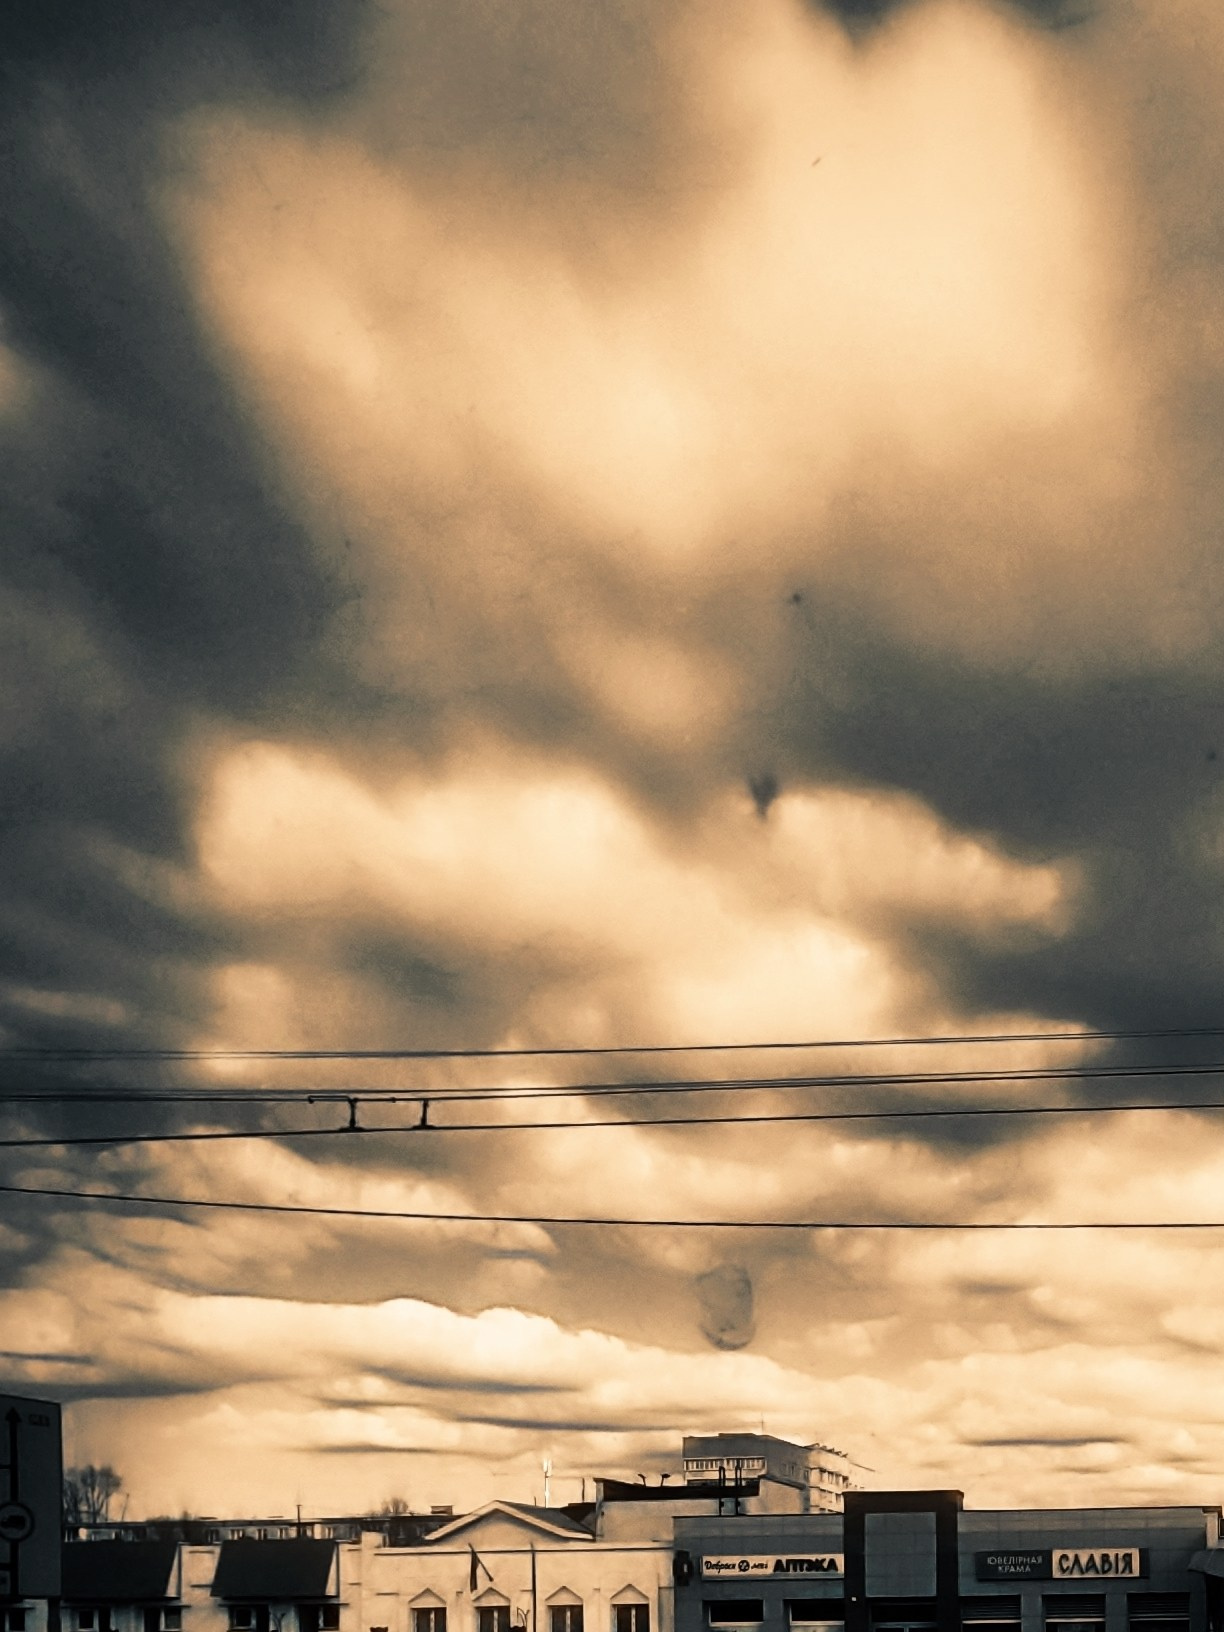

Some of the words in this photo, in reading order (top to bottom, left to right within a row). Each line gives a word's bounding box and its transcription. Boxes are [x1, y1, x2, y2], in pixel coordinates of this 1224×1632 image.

[773, 1558, 838, 1572] АПТЭКА
[987, 1556, 1043, 1565] ЮВЕЛІРНАЯ
[1058, 1553, 1133, 1574] СЛАВІЯ
[998, 1565, 1031, 1573] КРАМА
